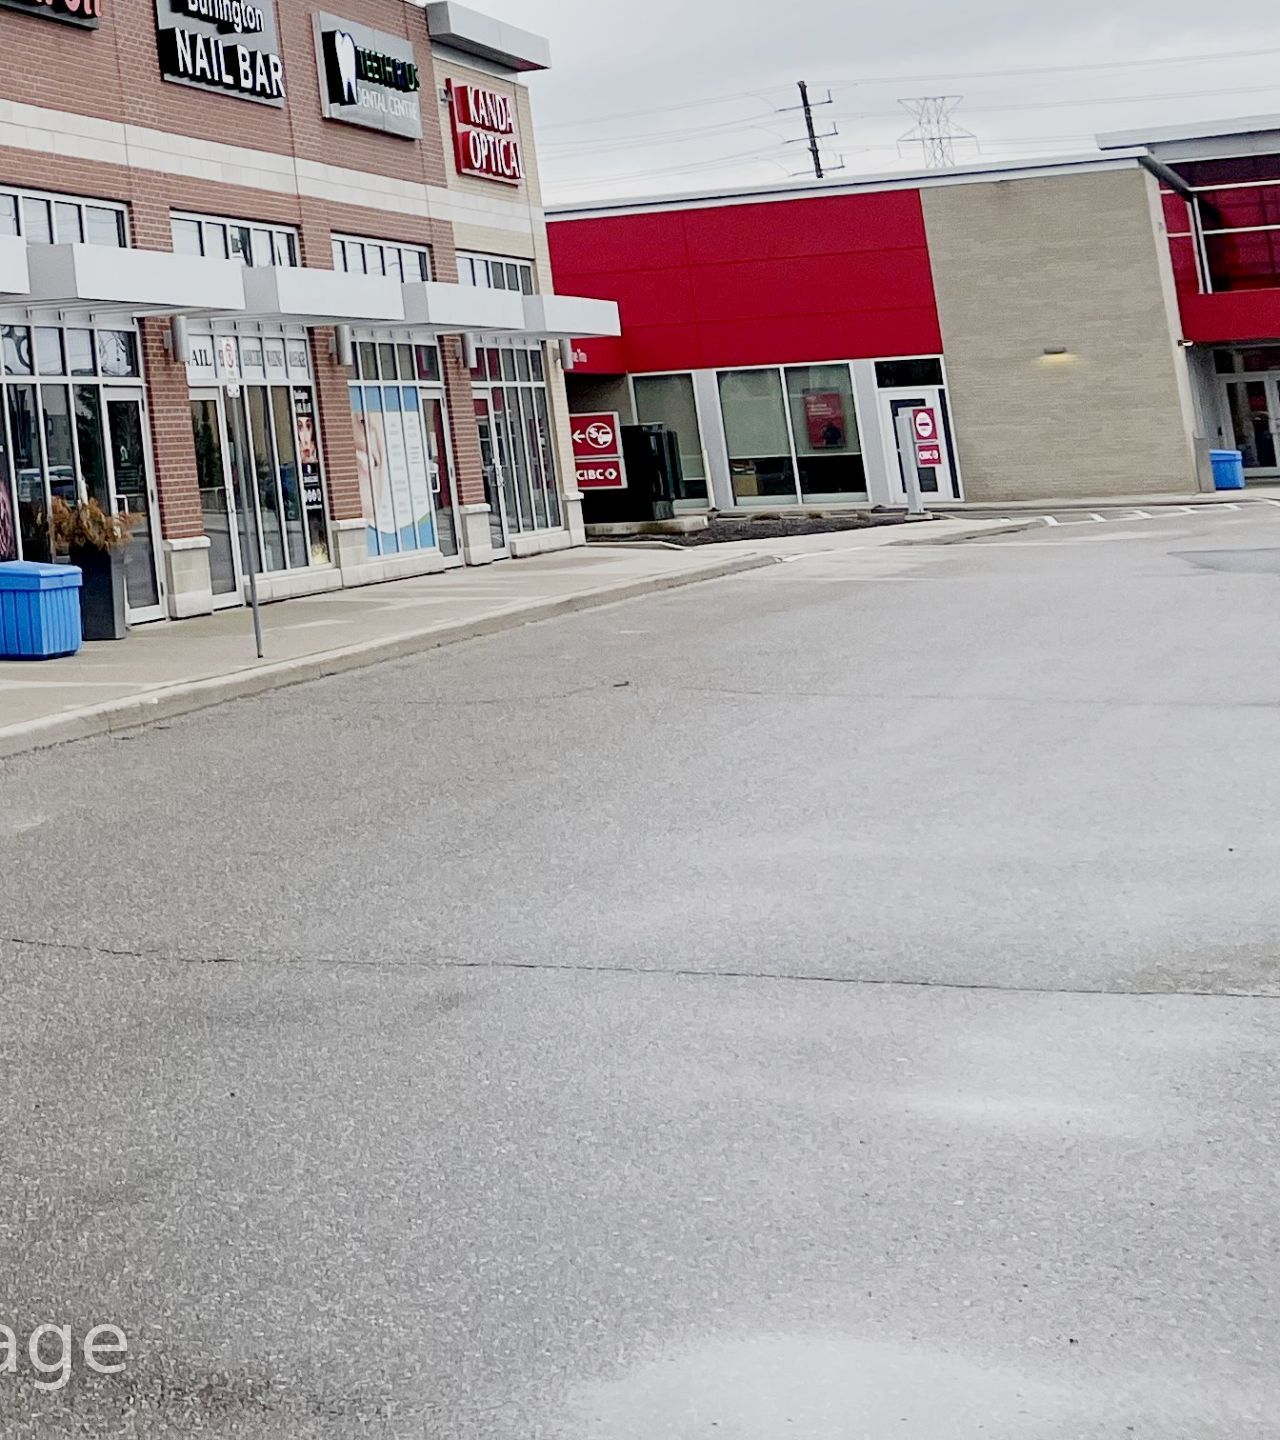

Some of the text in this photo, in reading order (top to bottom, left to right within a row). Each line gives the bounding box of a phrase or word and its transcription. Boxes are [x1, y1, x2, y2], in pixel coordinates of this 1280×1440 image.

[176, 27, 286, 98] NAIL BAR
[467, 86, 514, 134] KANDA
[469, 130, 526, 180] OPTICAL
[187, 349, 212, 367] AIL
[576, 469, 604, 481] CIBC
